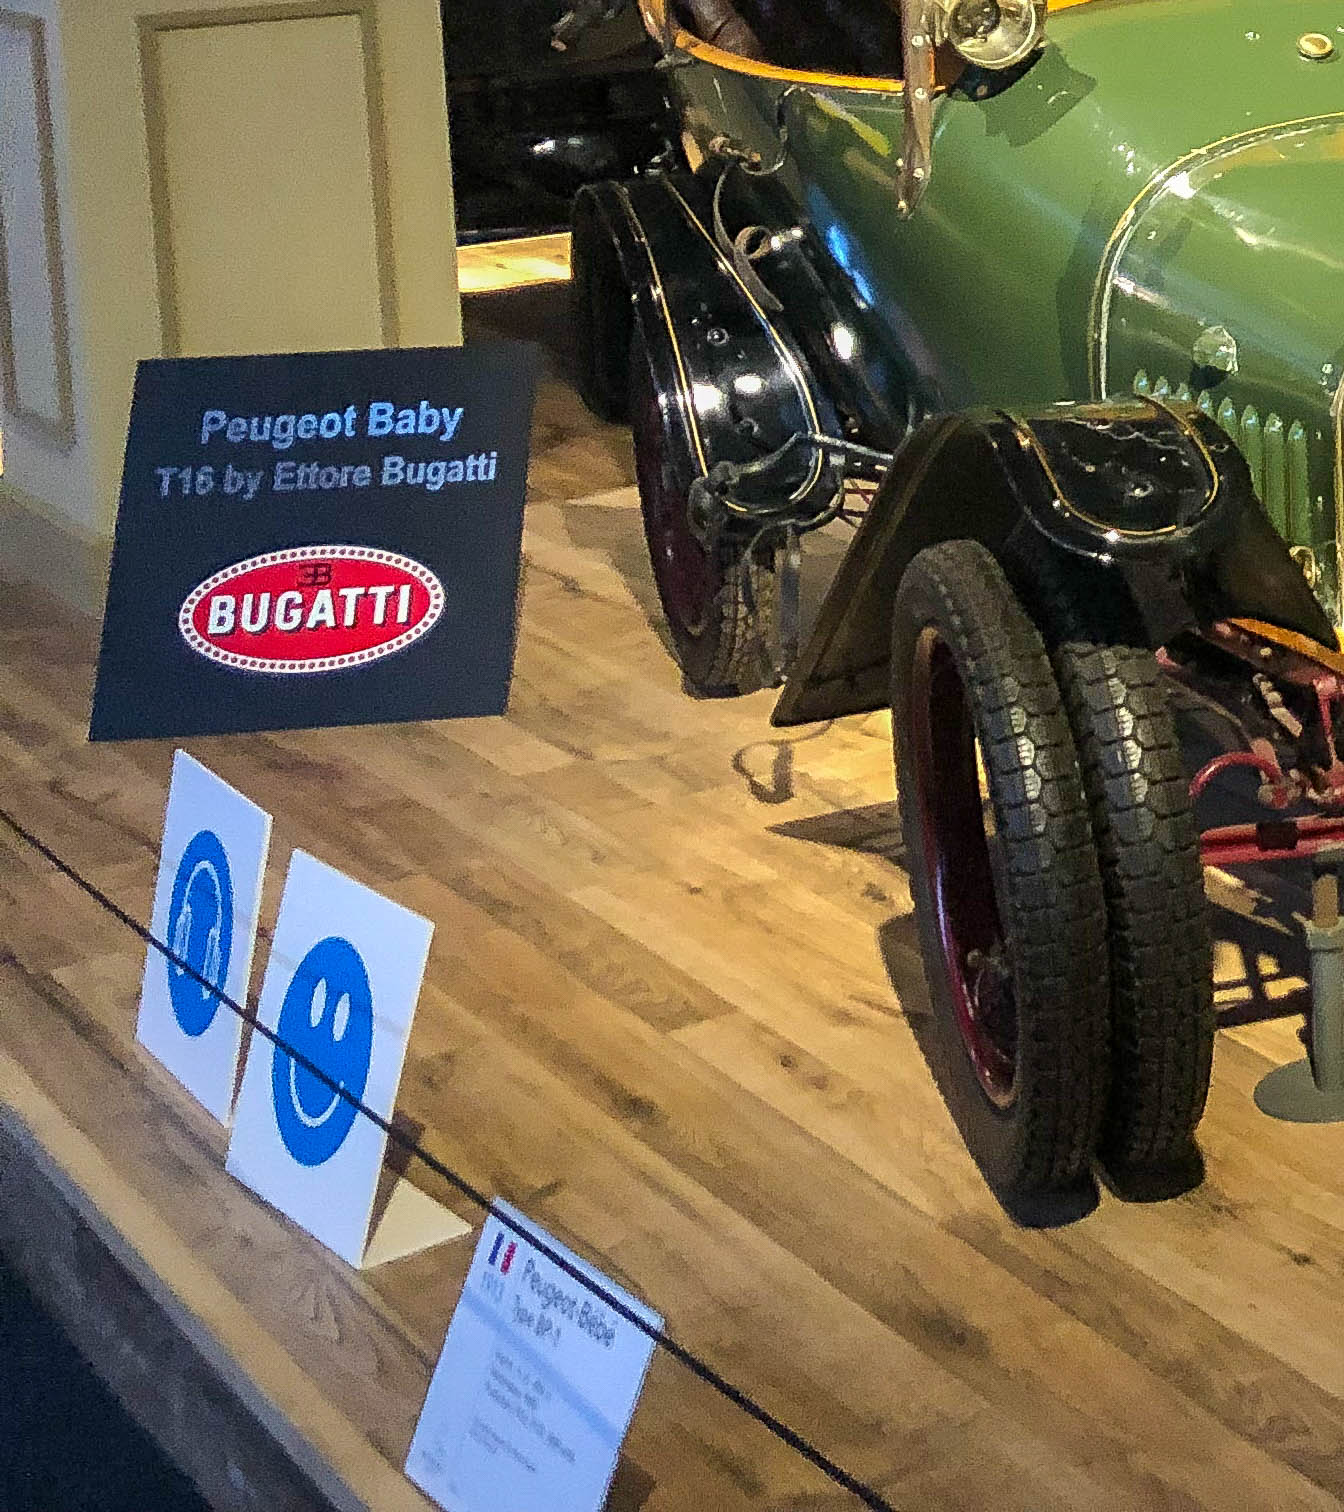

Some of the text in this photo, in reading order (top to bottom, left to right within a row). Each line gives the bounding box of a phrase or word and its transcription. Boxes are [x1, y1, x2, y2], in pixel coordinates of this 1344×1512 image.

[200, 400, 464, 449] Peugeot Baby
[156, 451, 499, 500] T16 by Ettore Bugatti
[207, 584, 412, 637] BUGATTI
